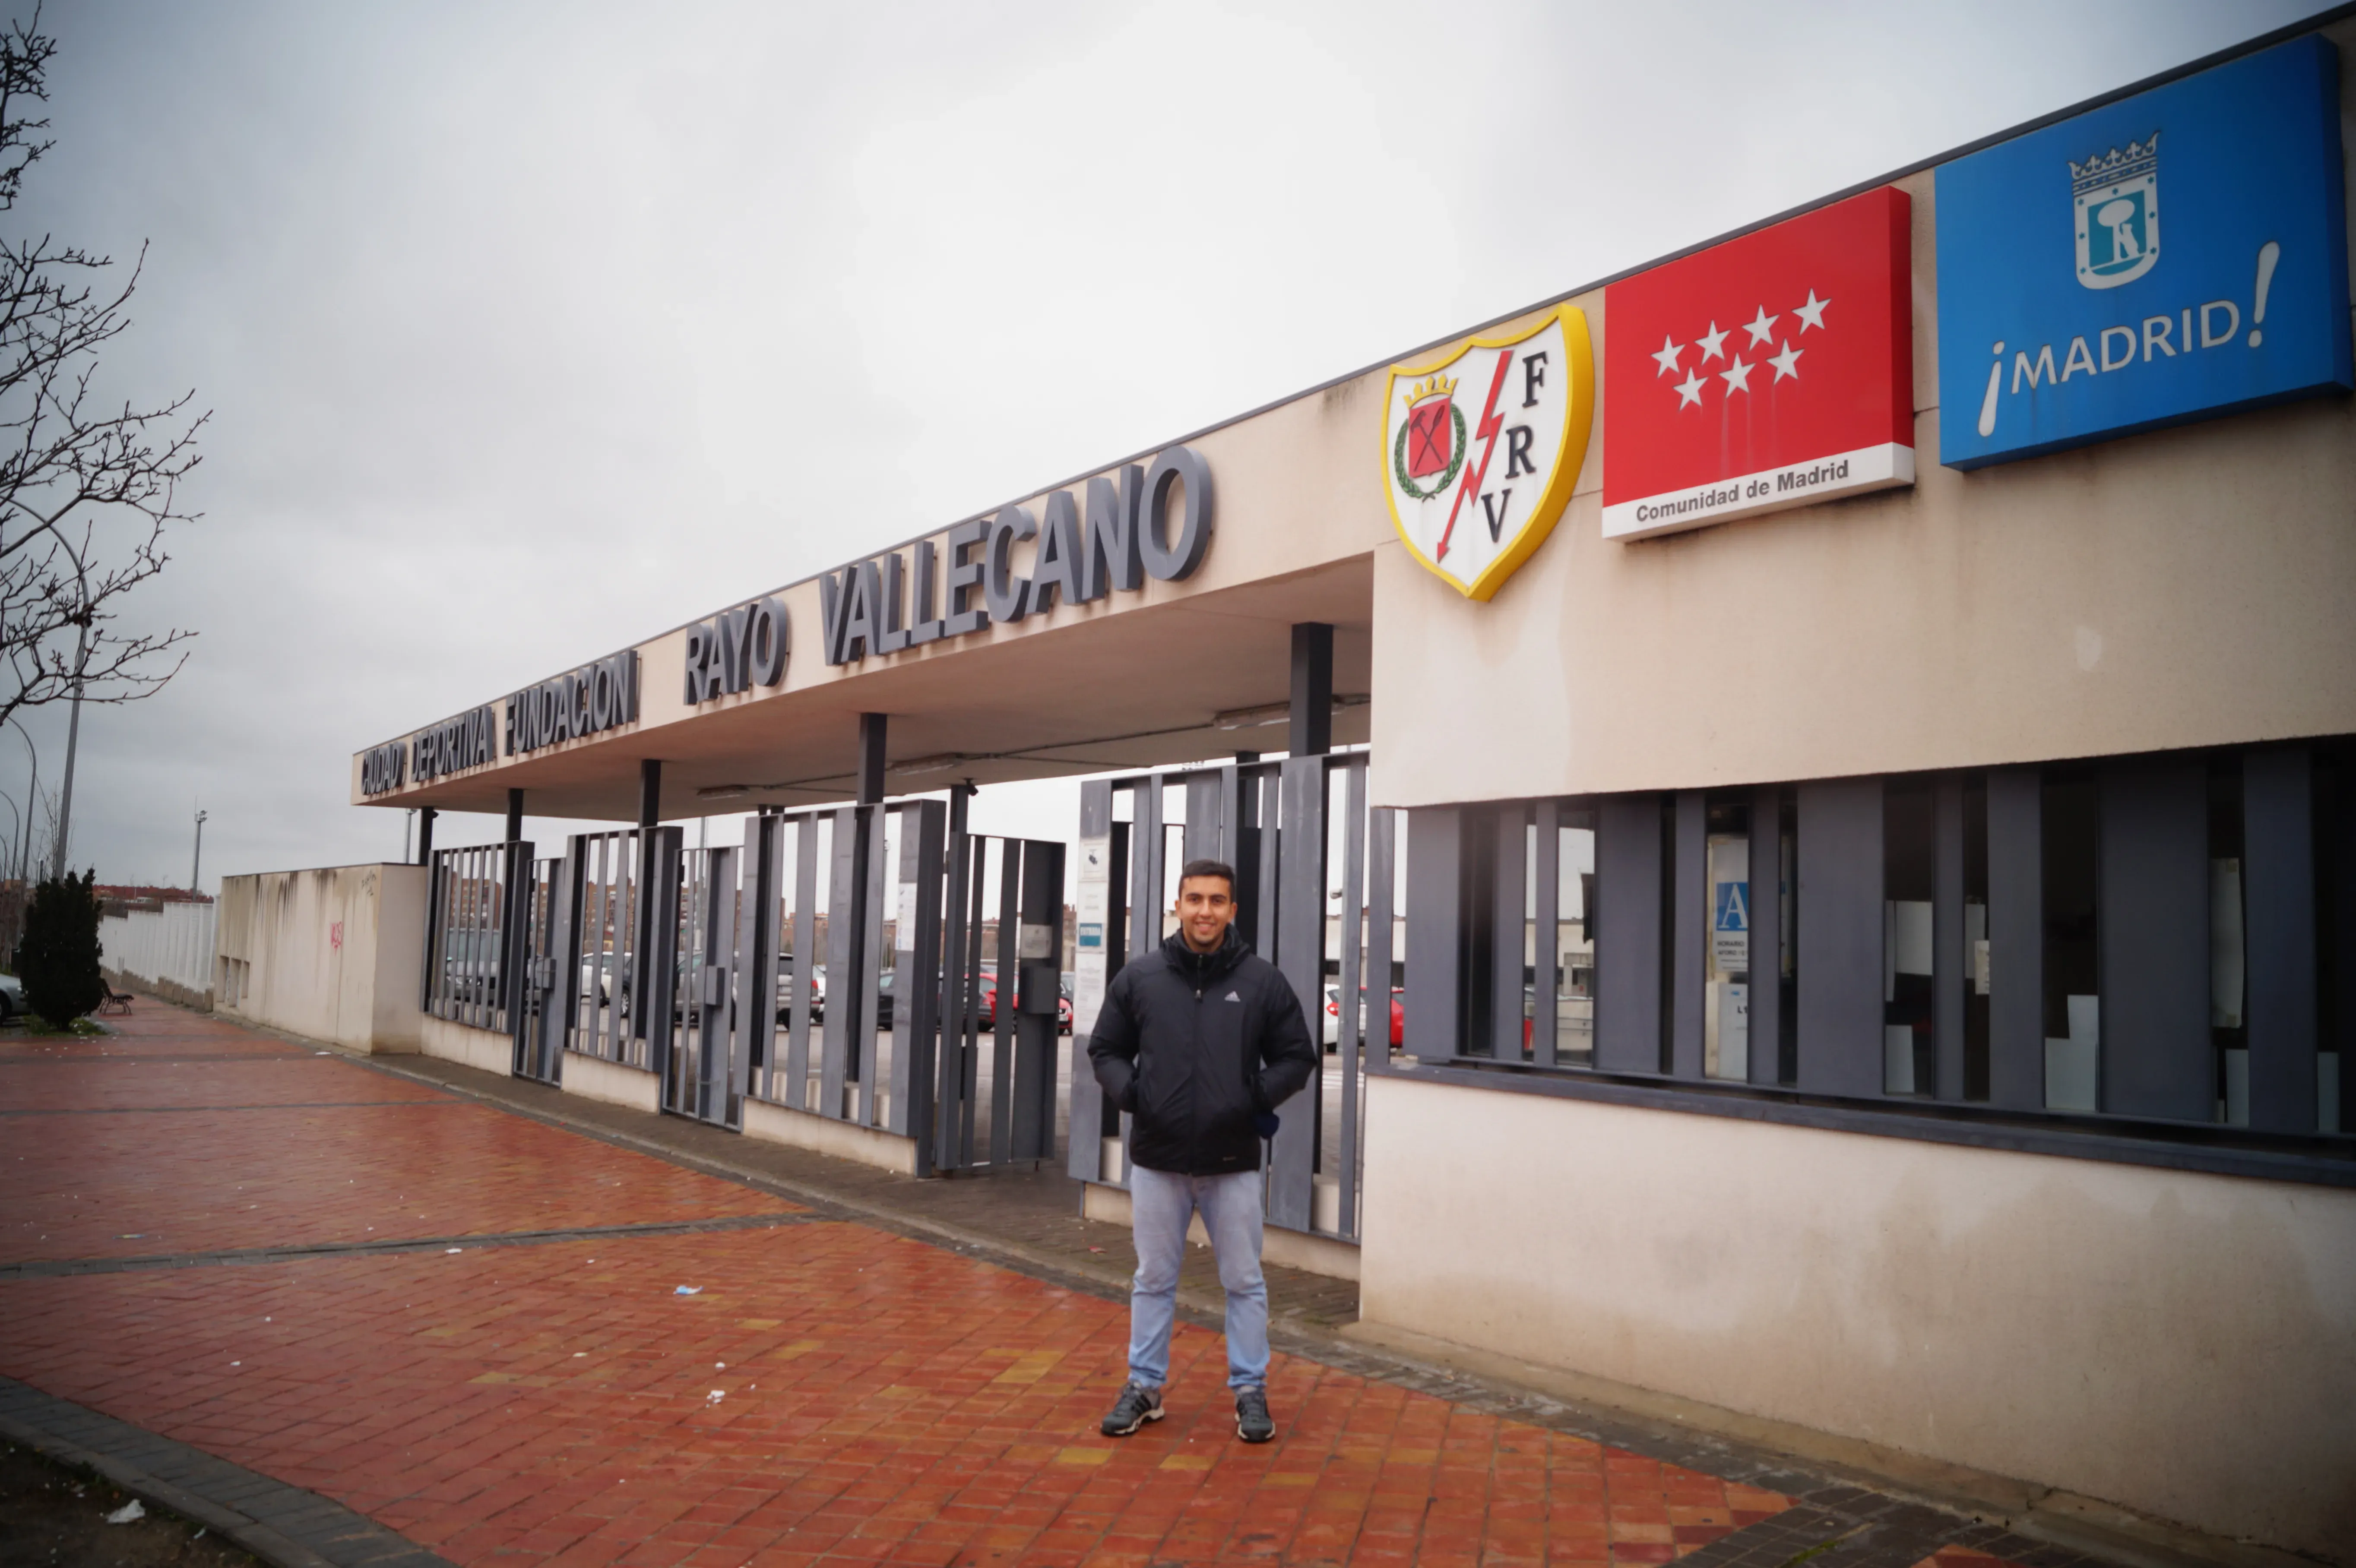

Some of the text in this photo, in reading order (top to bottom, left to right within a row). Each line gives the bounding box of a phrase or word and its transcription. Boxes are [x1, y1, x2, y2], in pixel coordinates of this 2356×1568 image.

[1636, 459, 1849, 522] Comunidad de Madrid
[362, 445, 1212, 795] CIUDAD DEPORTIVA FUNDACION RAYO VALLECANO
